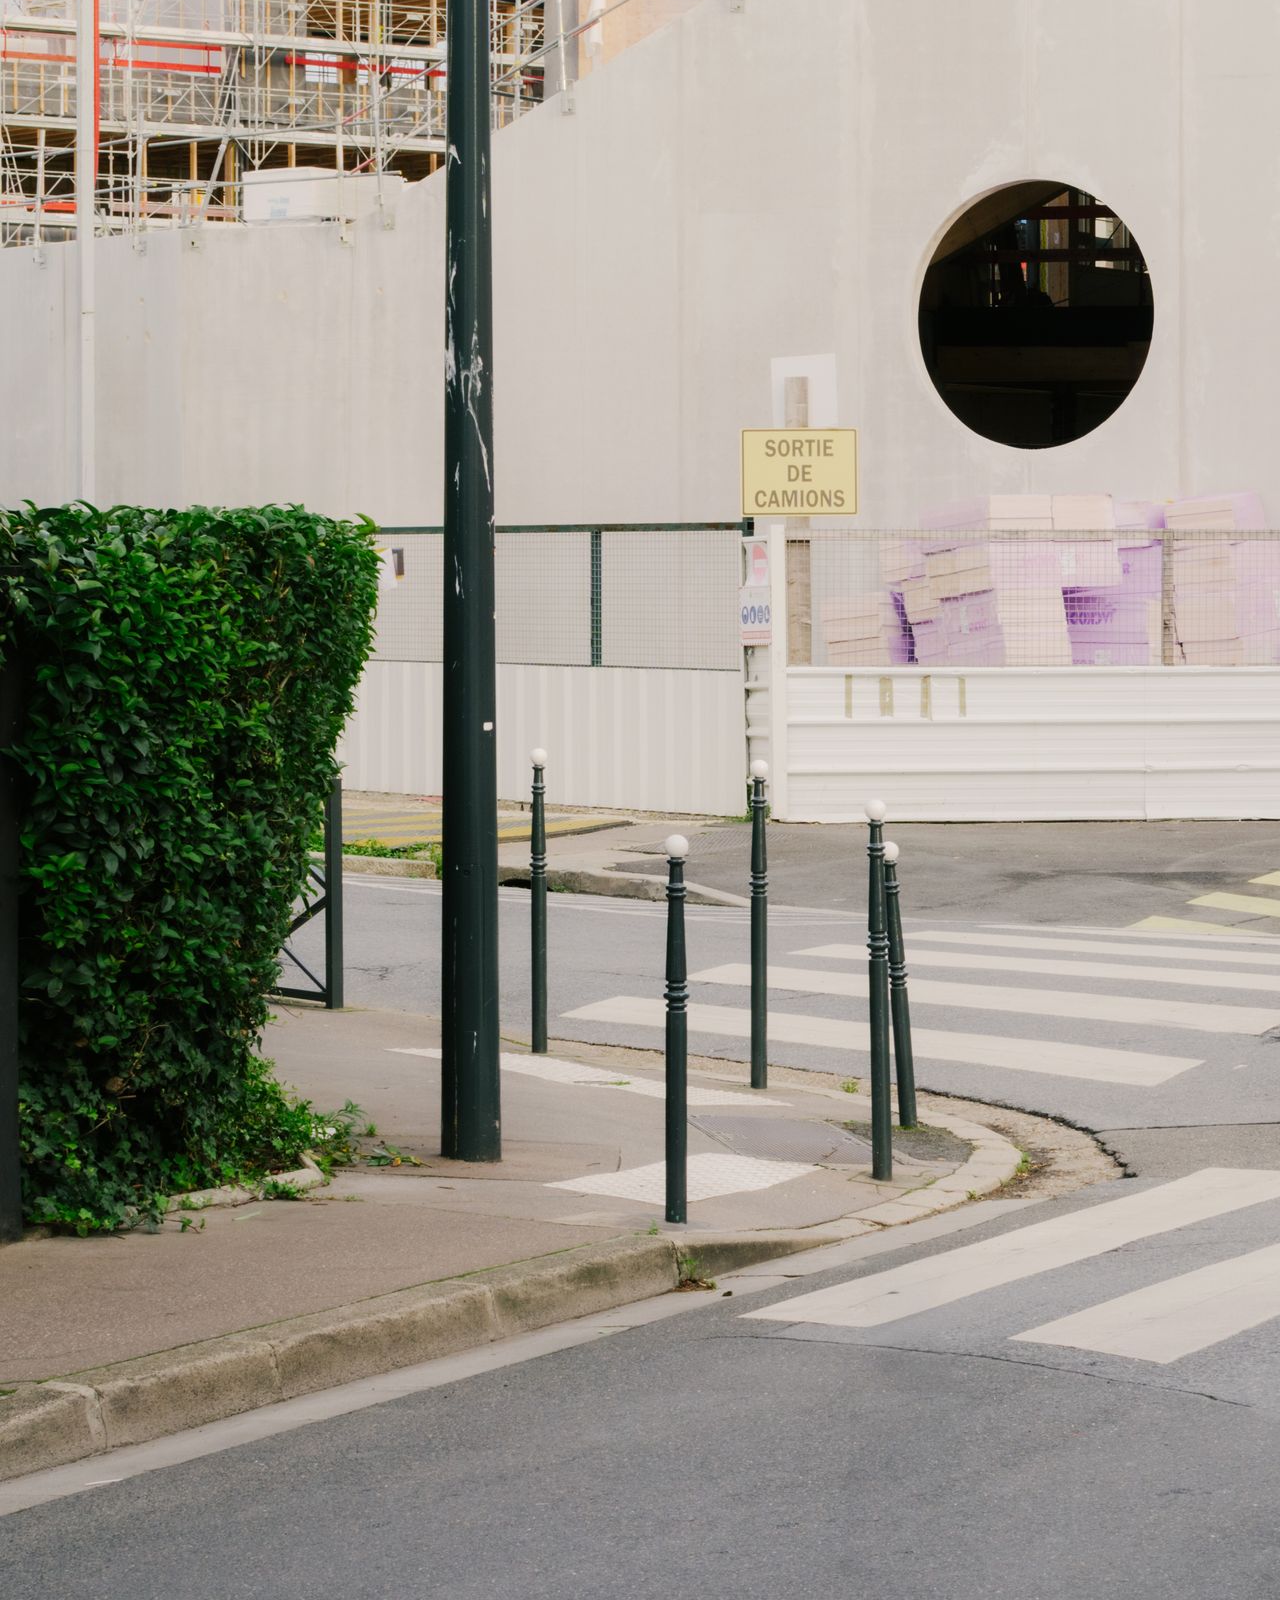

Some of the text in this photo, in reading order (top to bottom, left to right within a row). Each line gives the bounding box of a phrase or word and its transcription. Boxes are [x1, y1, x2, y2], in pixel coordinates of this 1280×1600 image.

[764, 439, 834, 457] SORTIE
[787, 464, 812, 482] DE
[754, 489, 846, 508] CAMIONS
